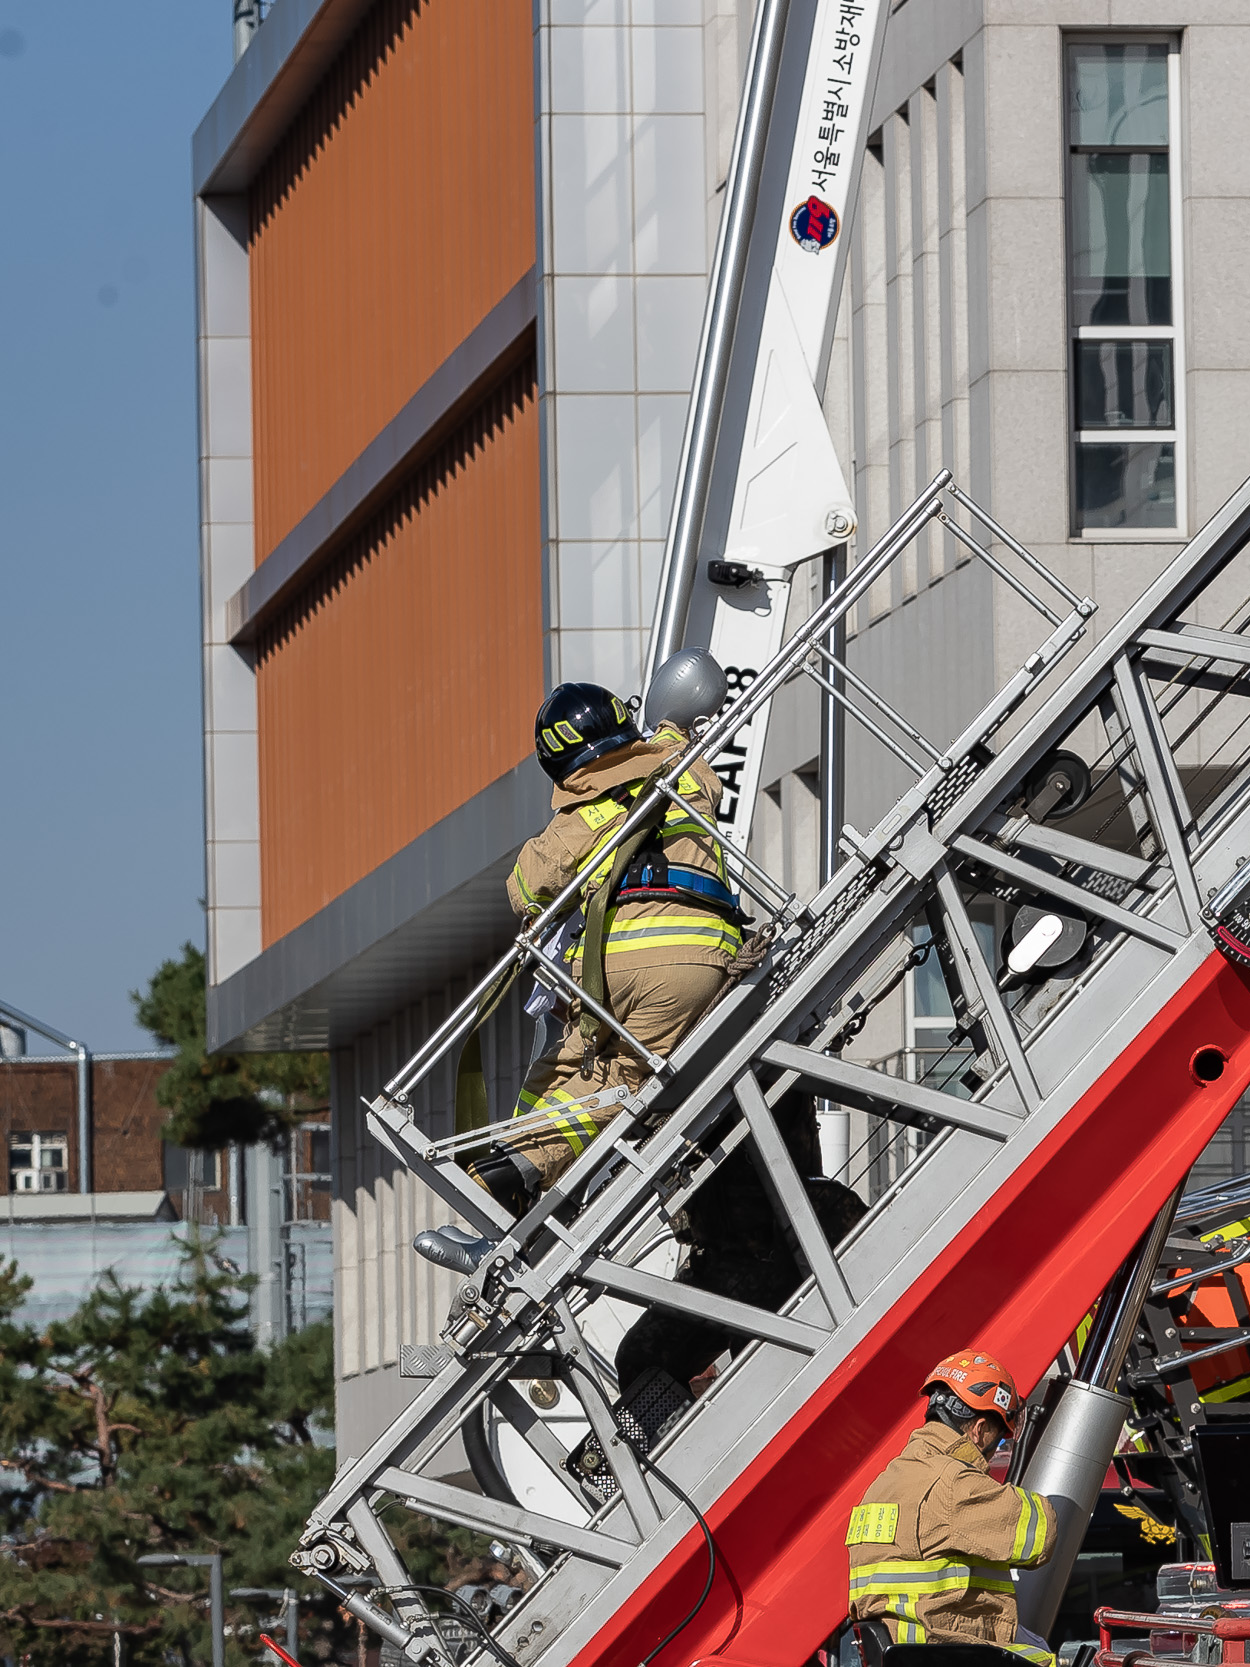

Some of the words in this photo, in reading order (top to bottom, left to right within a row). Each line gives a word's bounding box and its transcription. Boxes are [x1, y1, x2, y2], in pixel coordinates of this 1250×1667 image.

[812, 78, 851, 192] 서울특별시
[832, 0, 866, 75] 소방재
[806, 195, 830, 243] 119
[950, 1368, 969, 1383] FIRE
